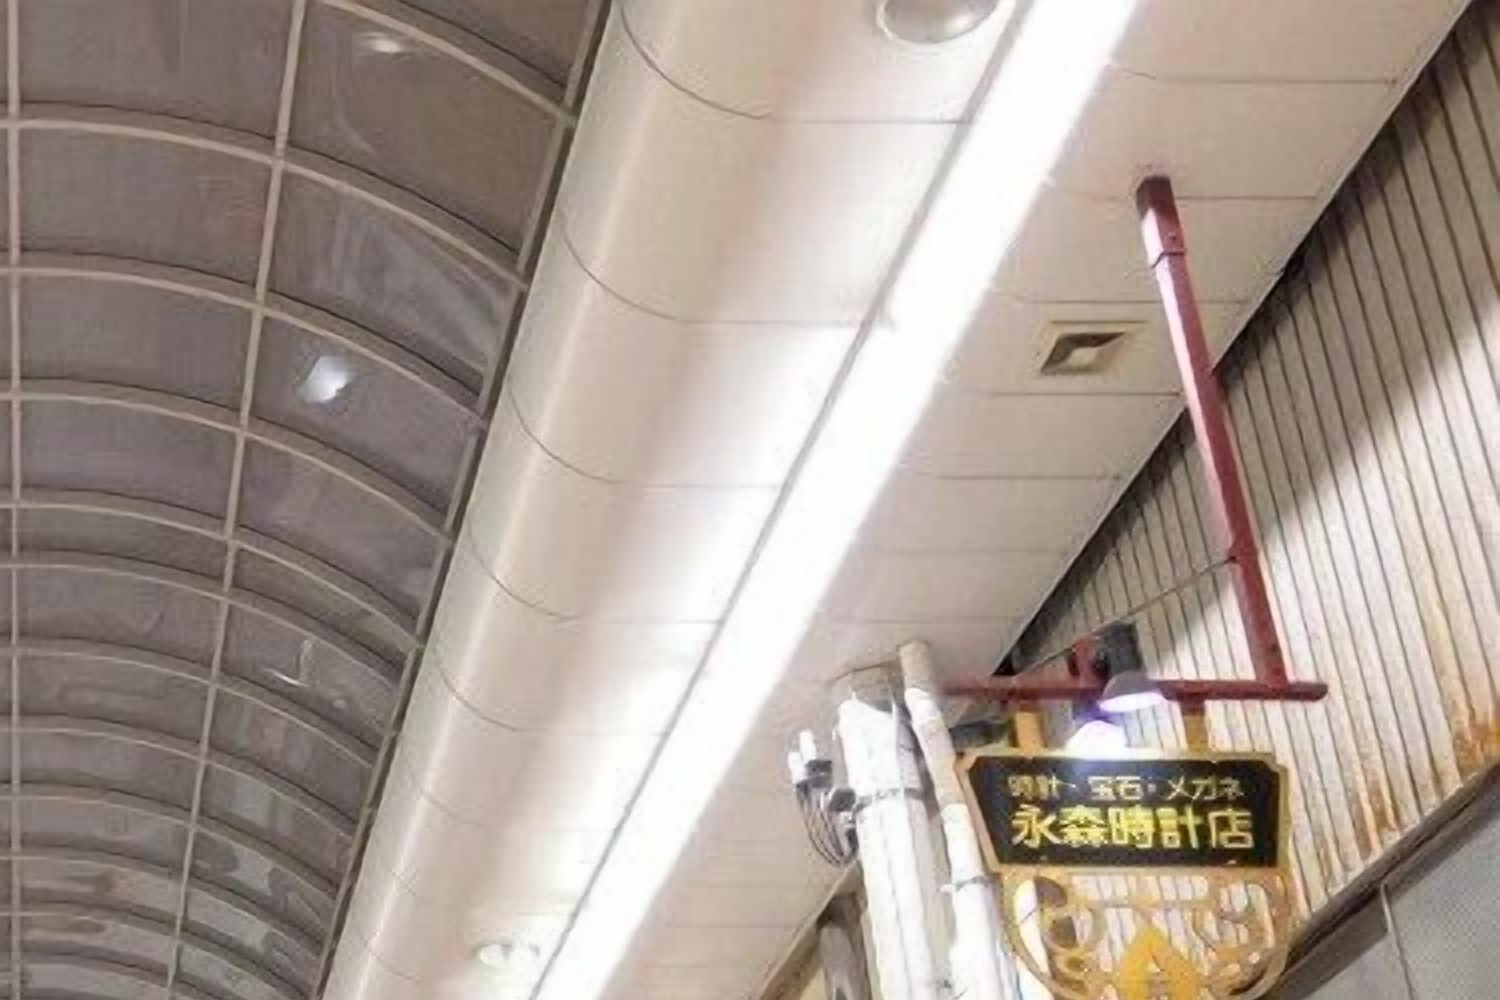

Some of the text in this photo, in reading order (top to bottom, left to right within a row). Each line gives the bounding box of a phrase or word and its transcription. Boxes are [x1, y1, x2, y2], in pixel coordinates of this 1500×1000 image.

[1011, 804, 1255, 849] 永森時計店
